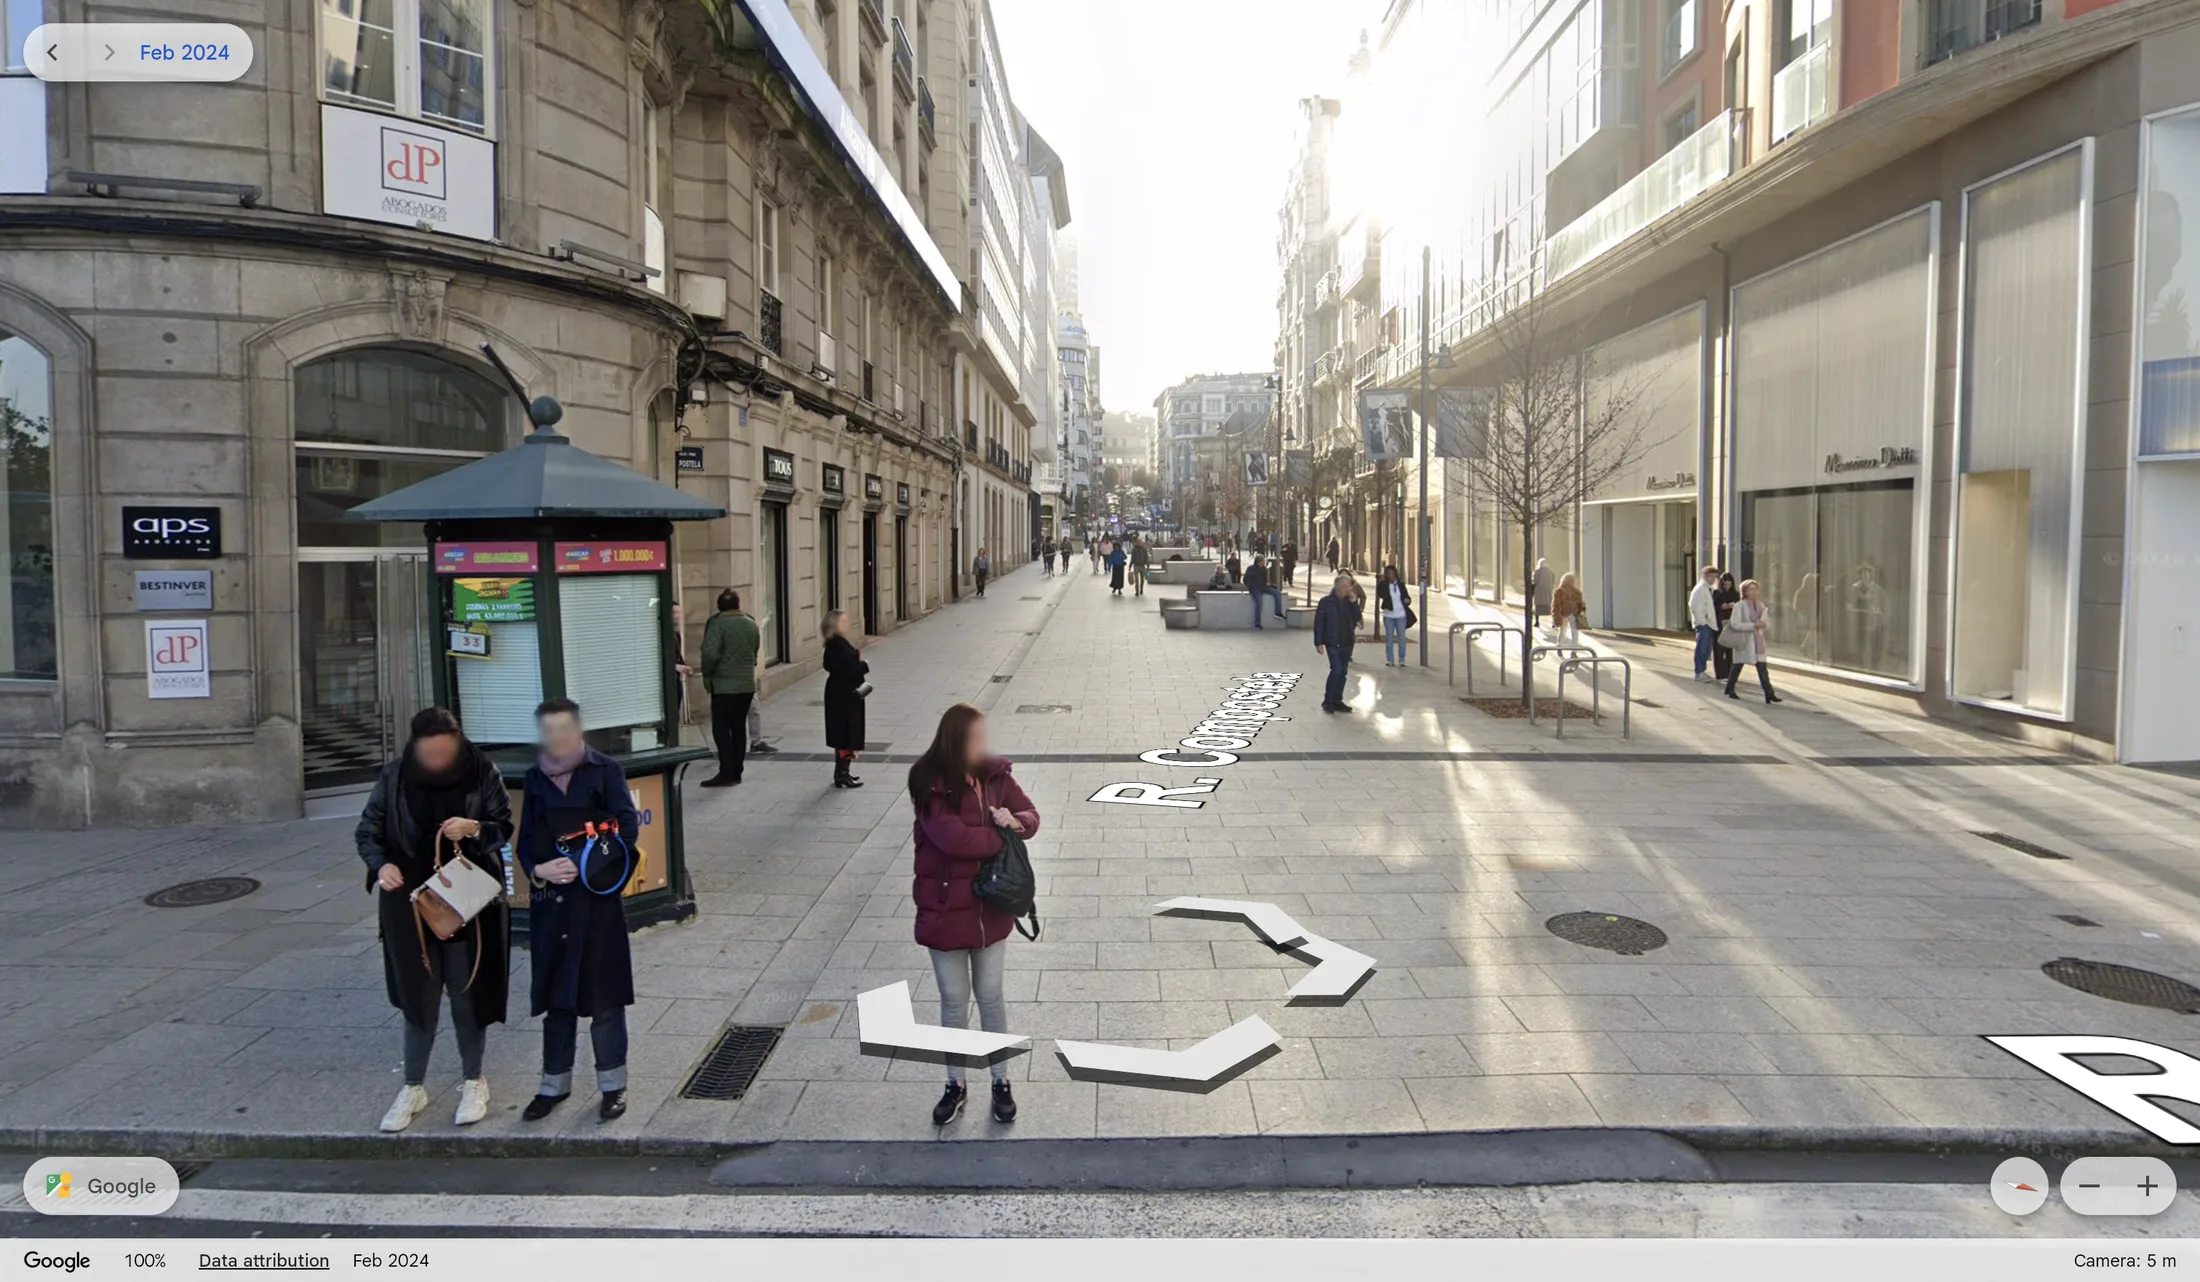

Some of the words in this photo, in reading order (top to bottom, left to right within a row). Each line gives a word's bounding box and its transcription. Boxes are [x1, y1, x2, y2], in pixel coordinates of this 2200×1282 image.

[381, 196, 447, 215] ABOGADOS
[381, 205, 447, 222] CONSULTORES
[774, 459, 792, 476] TOUS
[1823, 453, 1879, 475] Massimo
[1879, 446, 1918, 469] Dutti
[133, 518, 210, 539] aps
[140, 581, 206, 590] BESTINVER
